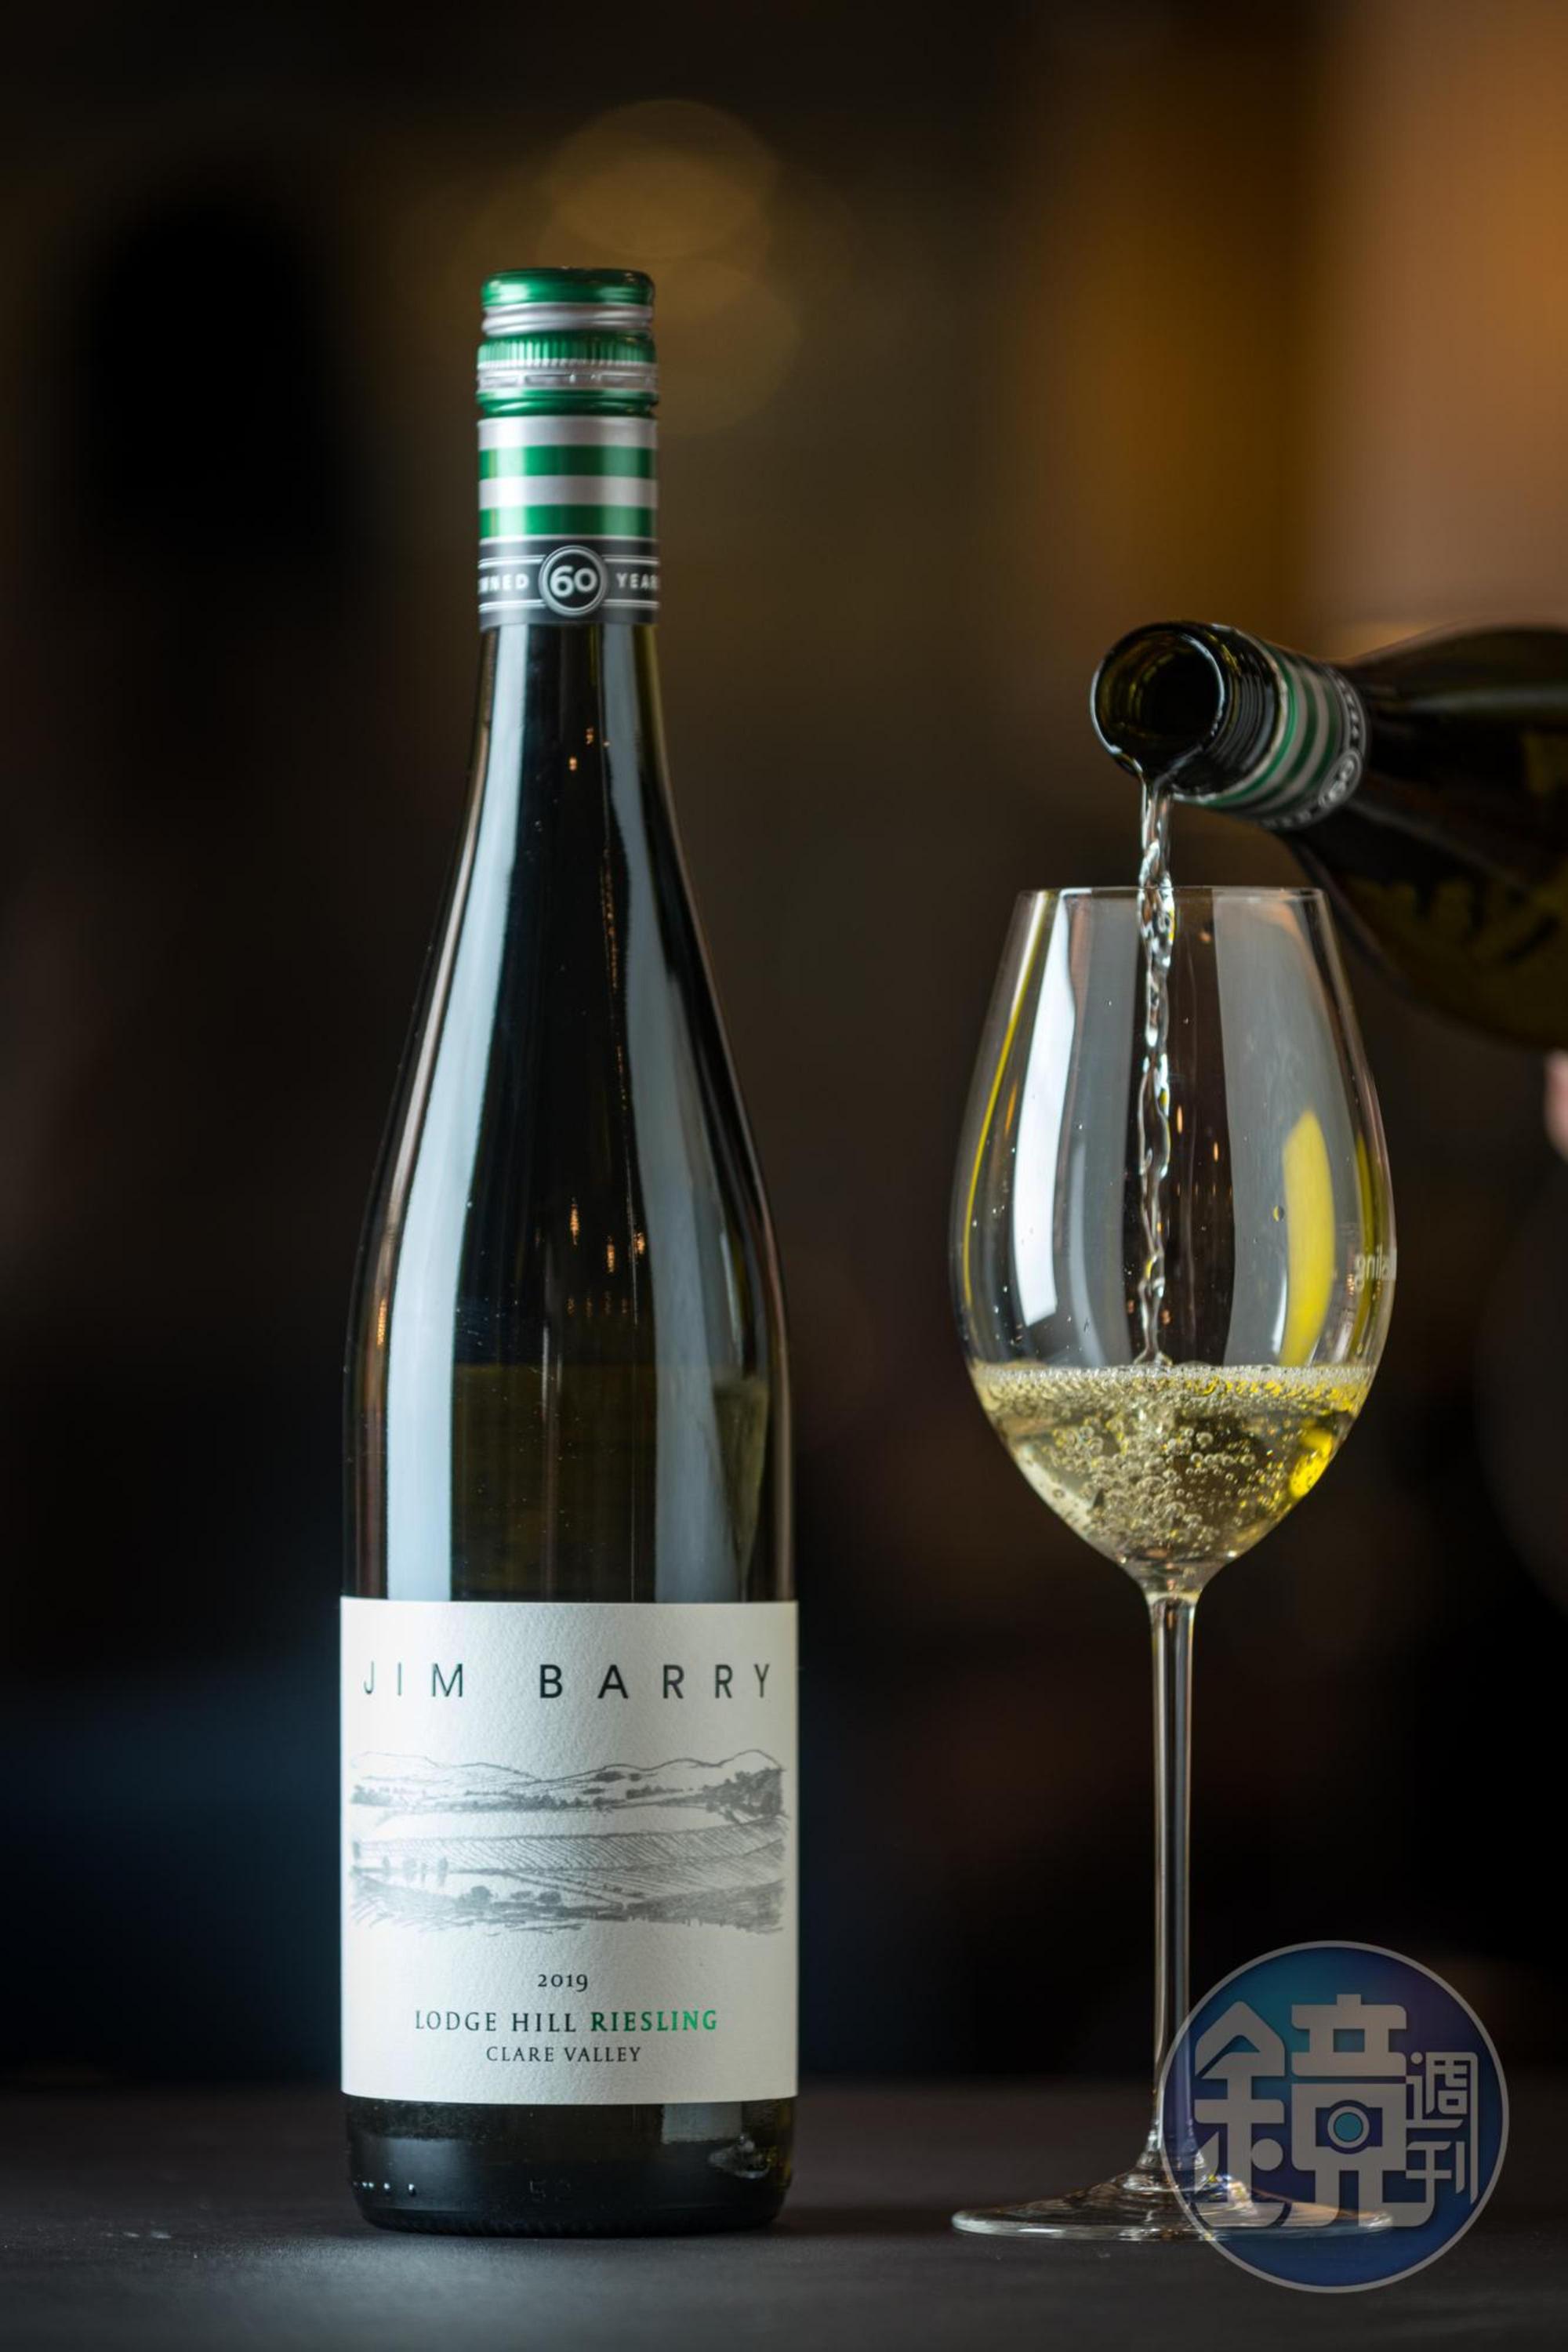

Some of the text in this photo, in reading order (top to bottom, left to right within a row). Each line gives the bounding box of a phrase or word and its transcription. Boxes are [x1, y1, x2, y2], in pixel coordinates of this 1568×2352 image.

[550, 565, 598, 598] 60
[363, 1661, 770, 1699] JIM BARRY
[537, 1973, 589, 1993] 2019
[415, 2009, 717, 2033] LODGE HILL RIESLING
[485, 2045, 641, 2063] CLARE VALLEY
